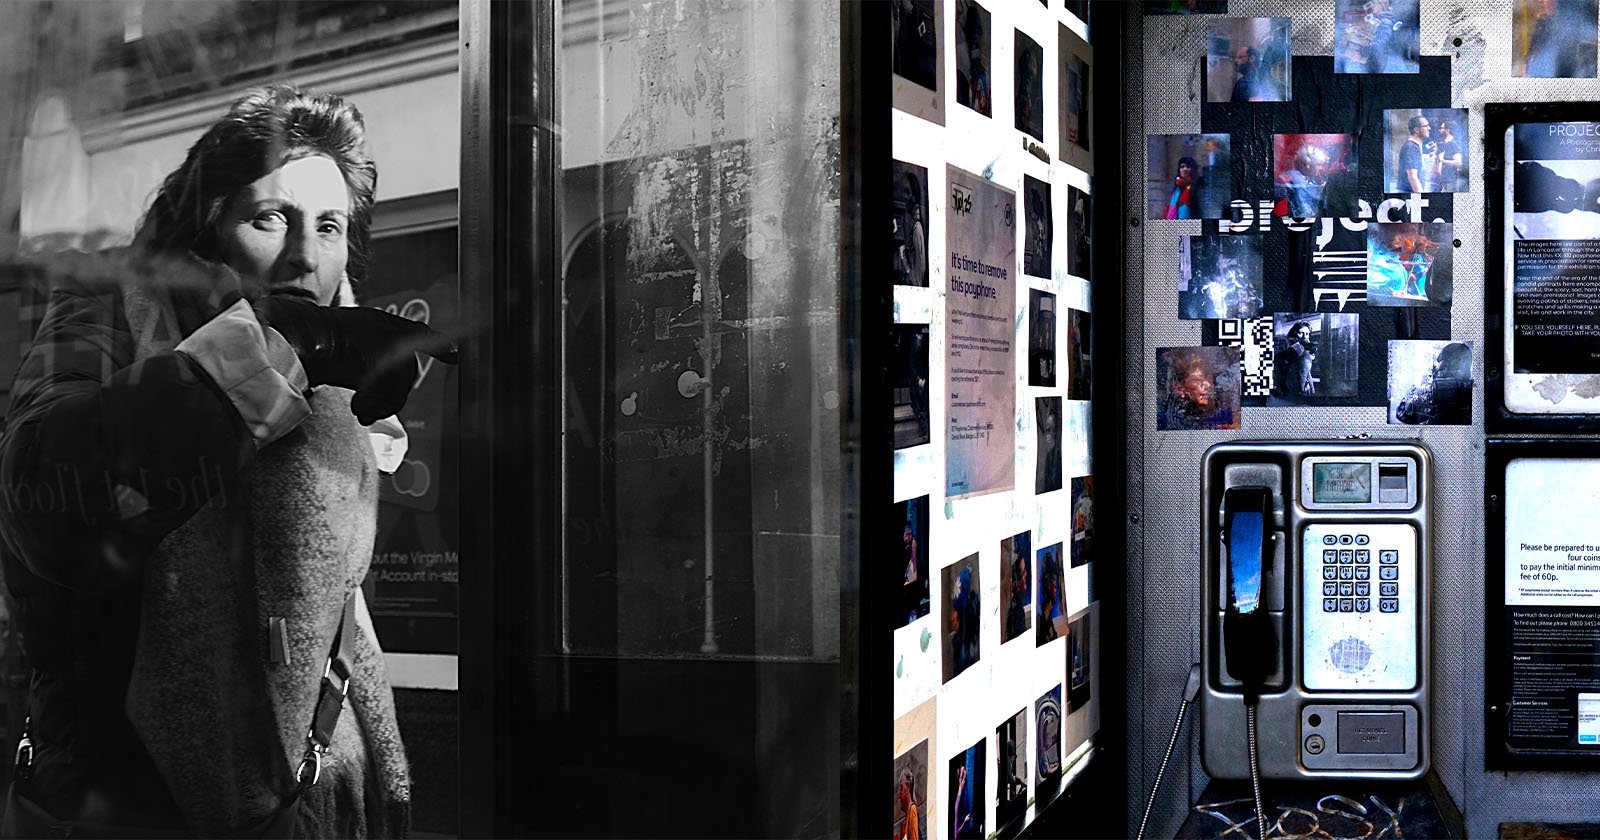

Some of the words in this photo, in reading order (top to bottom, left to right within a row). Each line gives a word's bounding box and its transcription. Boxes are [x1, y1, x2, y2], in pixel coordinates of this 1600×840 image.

[952, 252, 961, 270] It's
[962, 254, 977, 274] time
[978, 260, 984, 275] to
[985, 264, 1007, 280] remove
[951, 276, 964, 293] this
[1520, 543, 1542, 551] Please
[1554, 544, 1584, 552] prepared
[409, 552, 444, 567] Virgin
[1542, 572, 1558, 581] 60p.
